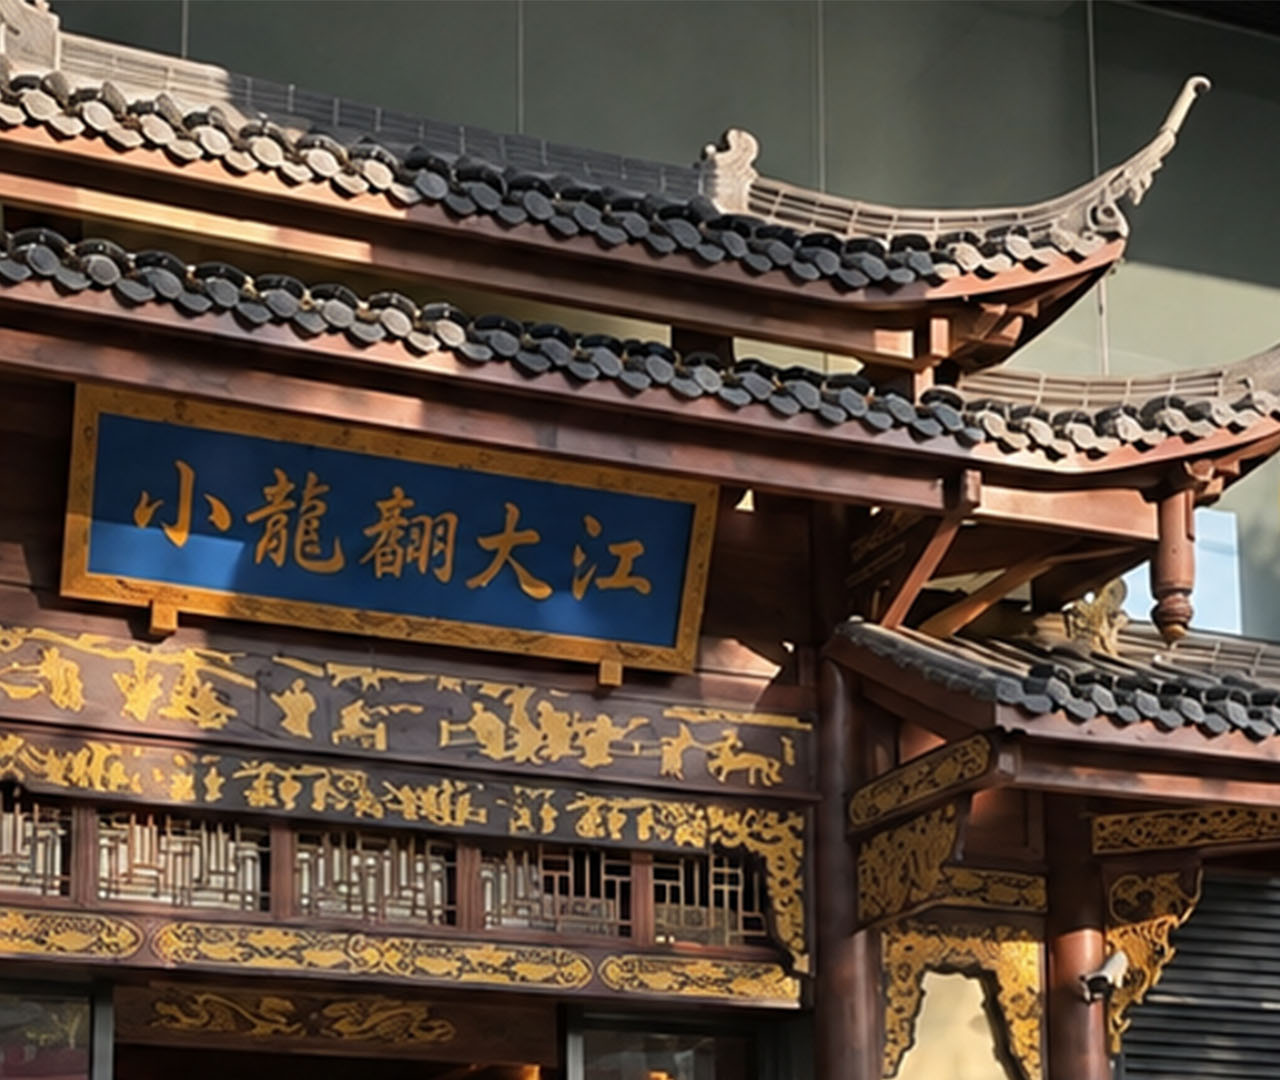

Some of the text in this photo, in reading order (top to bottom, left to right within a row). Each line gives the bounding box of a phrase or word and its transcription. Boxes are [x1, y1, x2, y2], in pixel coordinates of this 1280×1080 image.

[133, 459, 653, 601] 小龍翻大江
